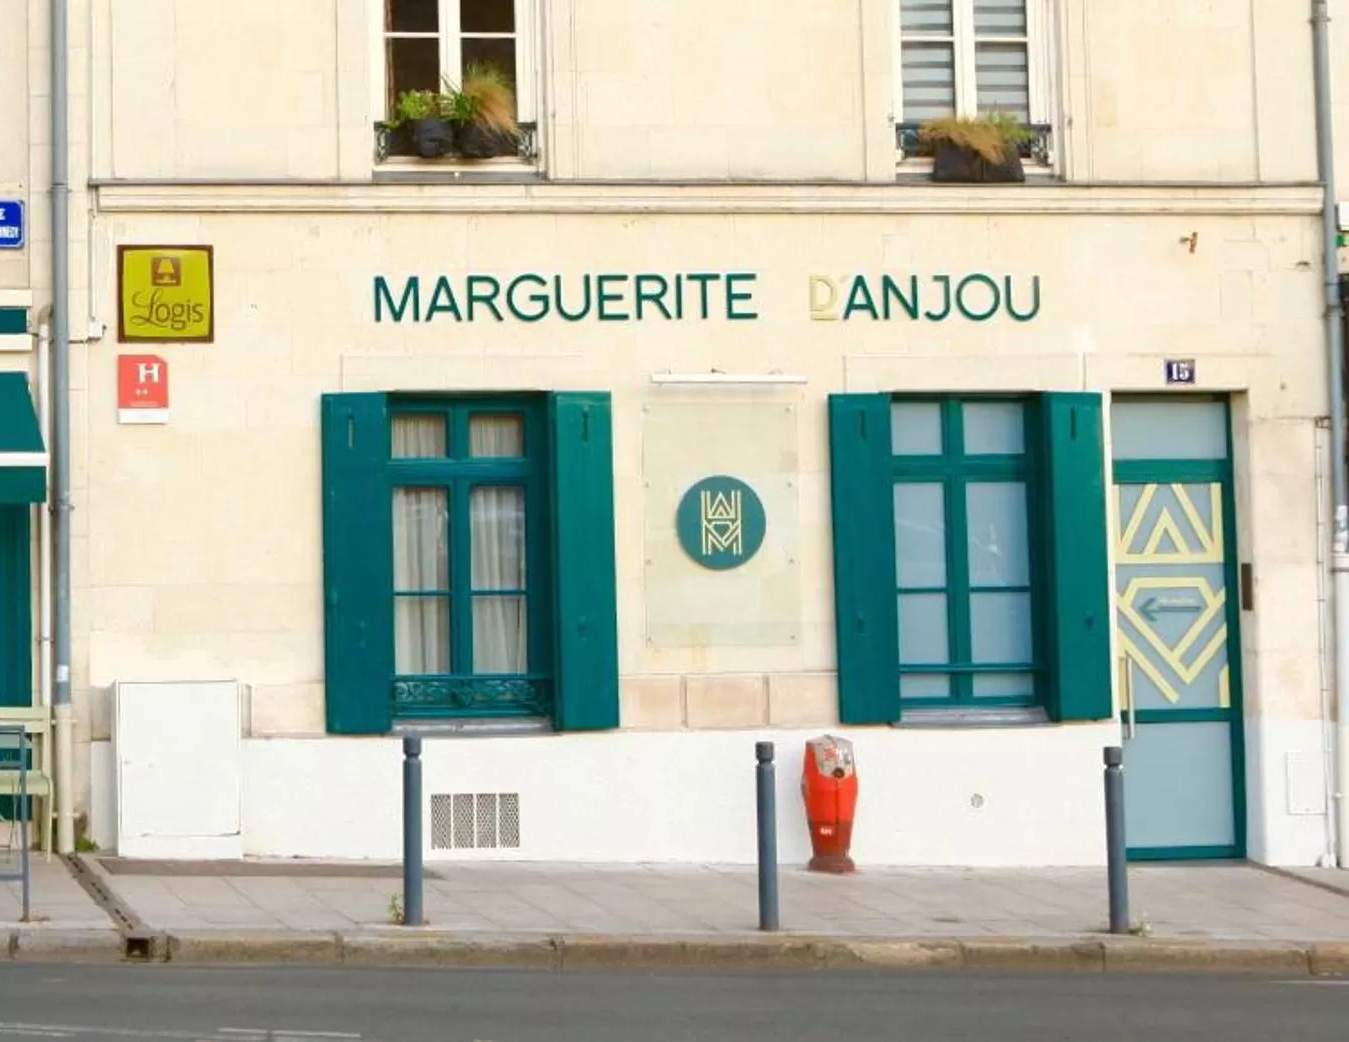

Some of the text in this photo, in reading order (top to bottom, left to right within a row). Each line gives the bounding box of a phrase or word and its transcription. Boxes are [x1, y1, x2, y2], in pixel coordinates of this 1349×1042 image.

[130, 288, 204, 331] Logis
[372, 272, 1041, 323] MARGUERITE D'ANJOU
[137, 362, 160, 384] H
